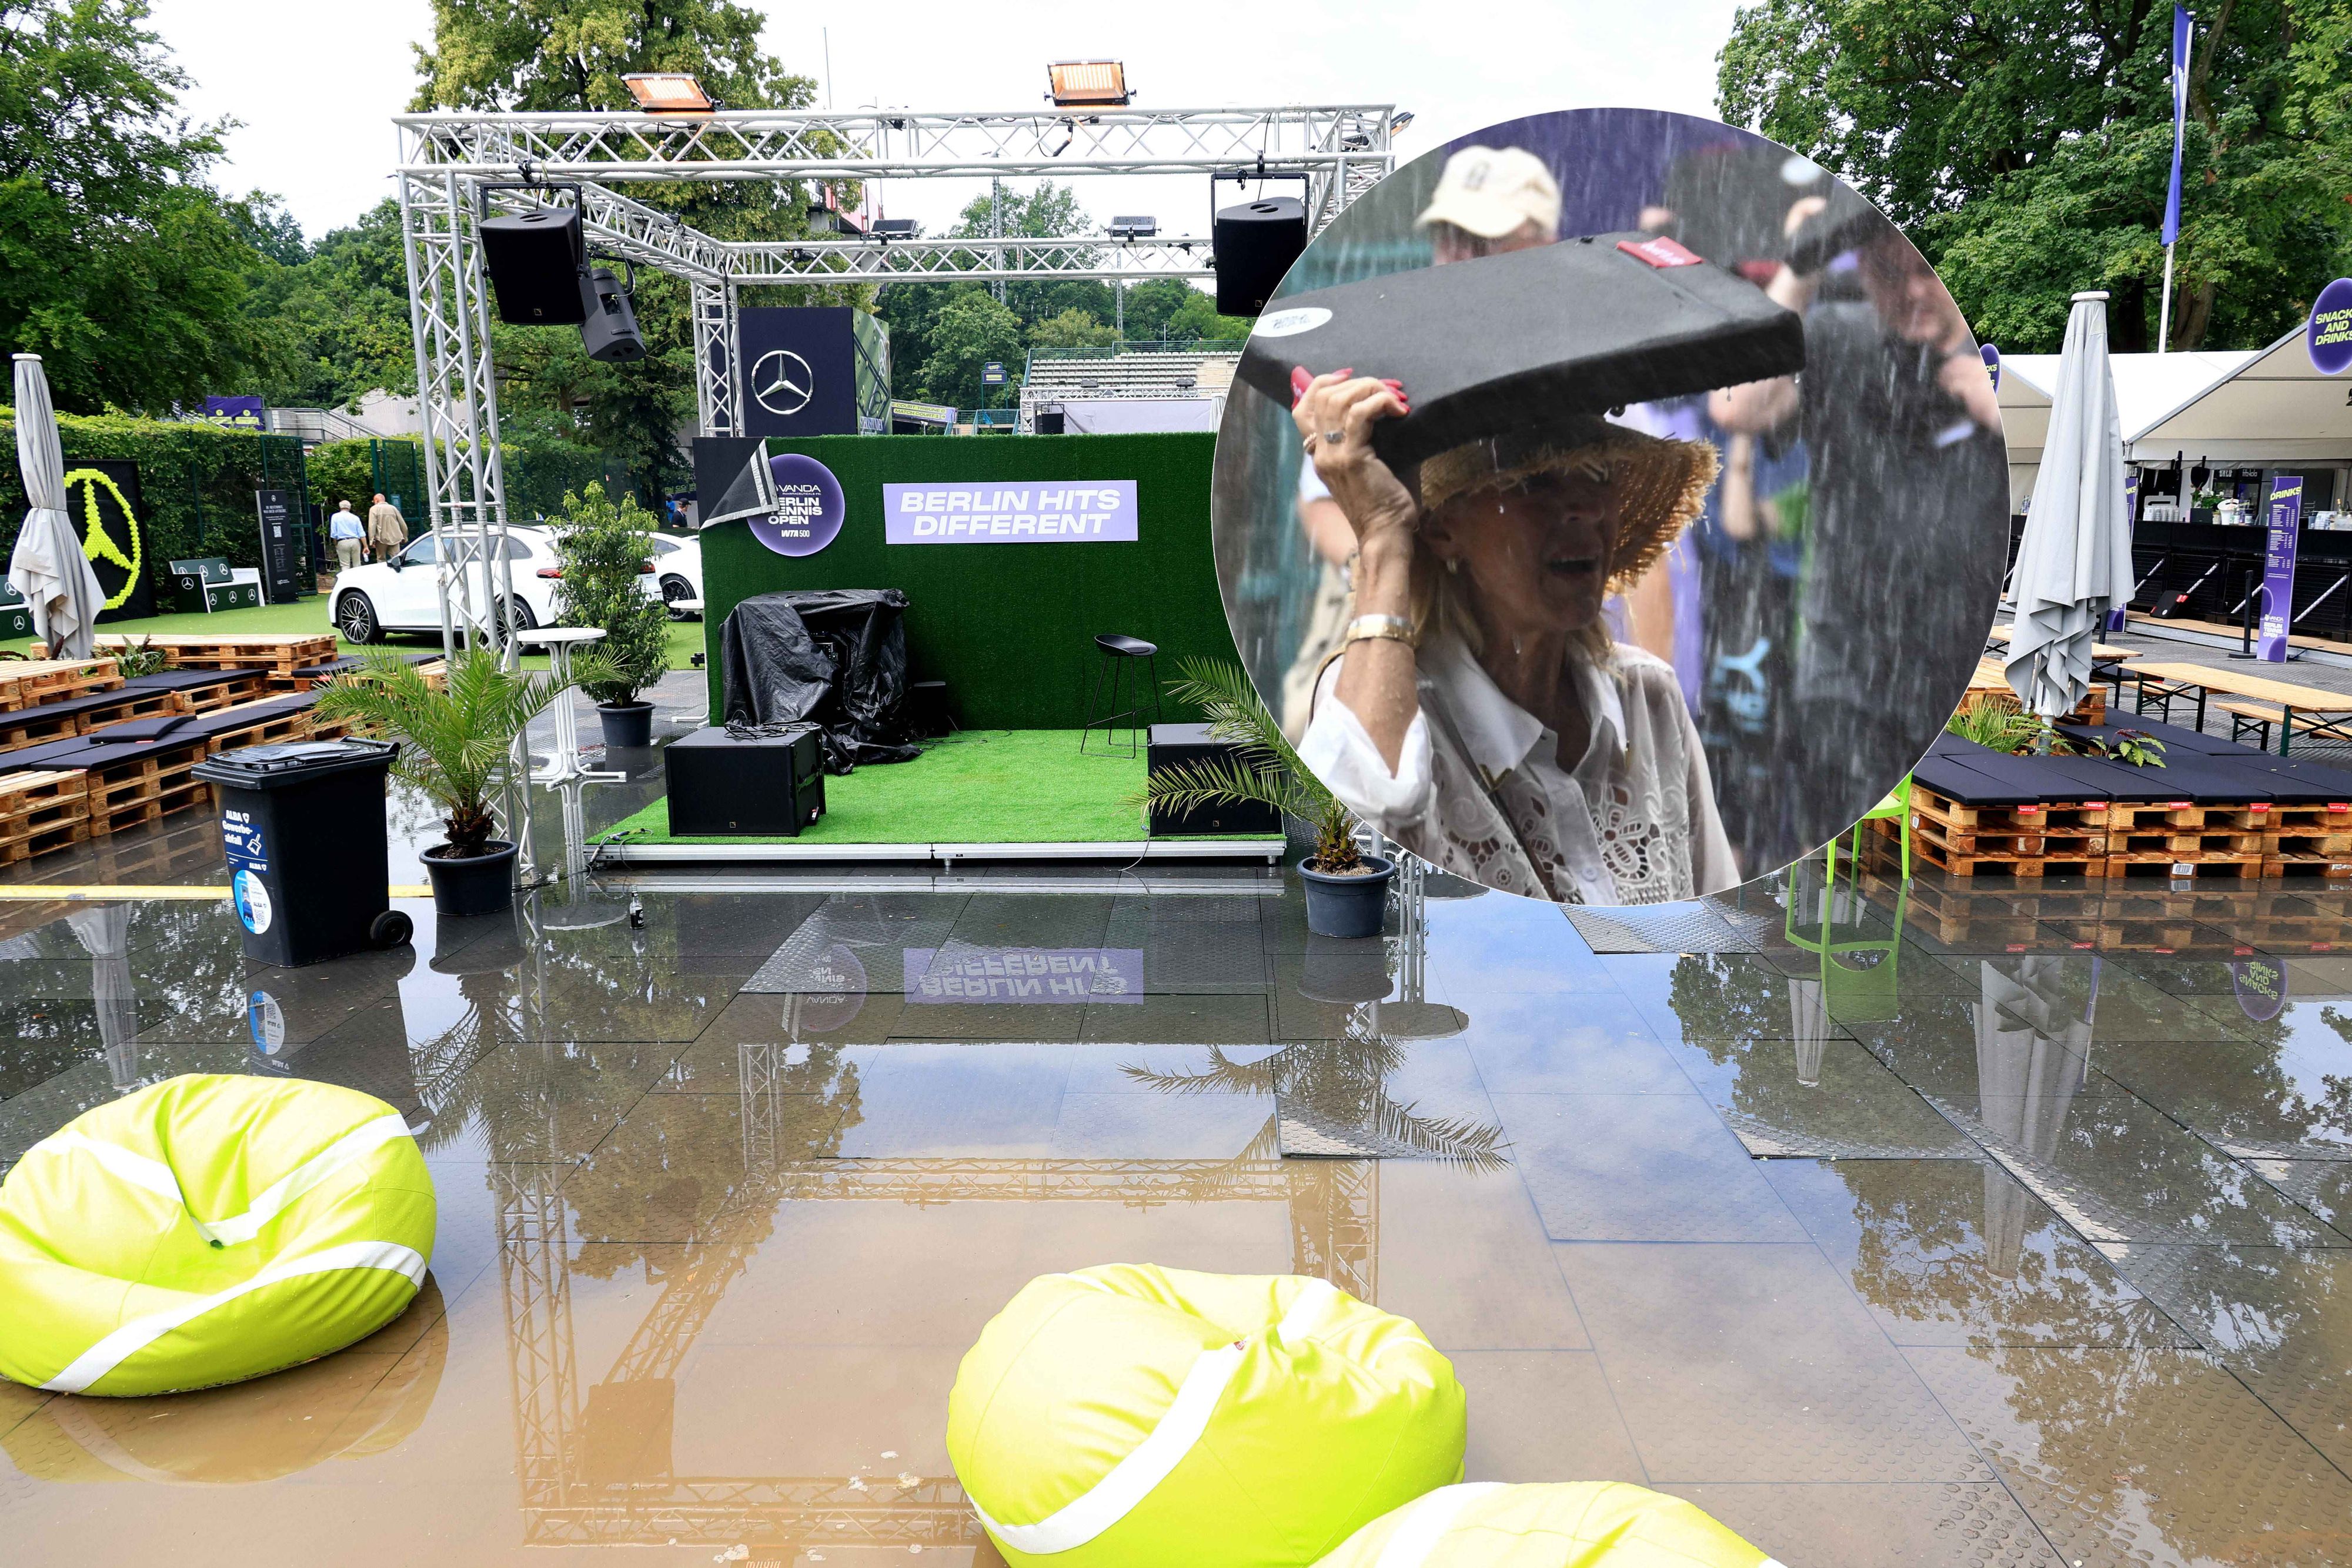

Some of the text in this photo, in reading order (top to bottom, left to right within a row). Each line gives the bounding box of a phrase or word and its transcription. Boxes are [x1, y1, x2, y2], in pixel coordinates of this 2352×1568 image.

[2315, 309, 2352, 324] SNACK
[2324, 320, 2349, 333] AND
[2270, 486, 2302, 501] DRINKS
[778, 497, 820, 506] ERLIN
[900, 489, 1121, 513] BERLIN HITS
[771, 506, 823, 516] ENNIS
[767, 516, 809, 525] OPEN
[913, 513, 1111, 536] DIFFERENT
[226, 810, 243, 822] ALBA
[222, 820, 253, 834] Gewerbe-
[225, 834, 242, 845] abfall
